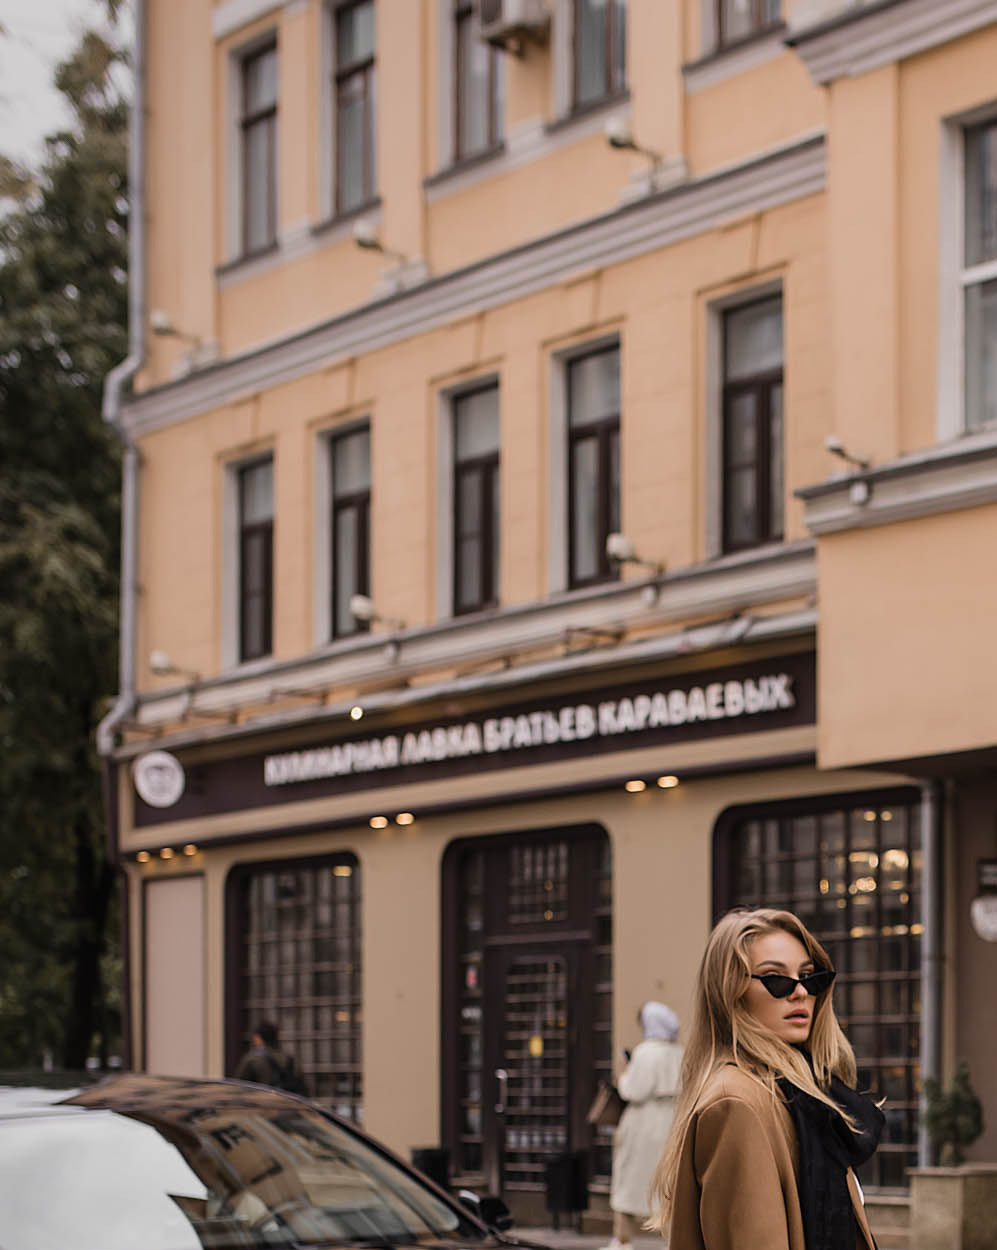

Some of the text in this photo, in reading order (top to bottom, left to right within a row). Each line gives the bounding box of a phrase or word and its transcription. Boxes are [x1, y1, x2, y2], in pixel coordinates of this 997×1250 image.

[400, 721, 483, 765] ЛАВКА
[483, 704, 596, 753] БРАТЬЕВ
[598, 673, 796, 736] КАРАВАЕВЫХ
